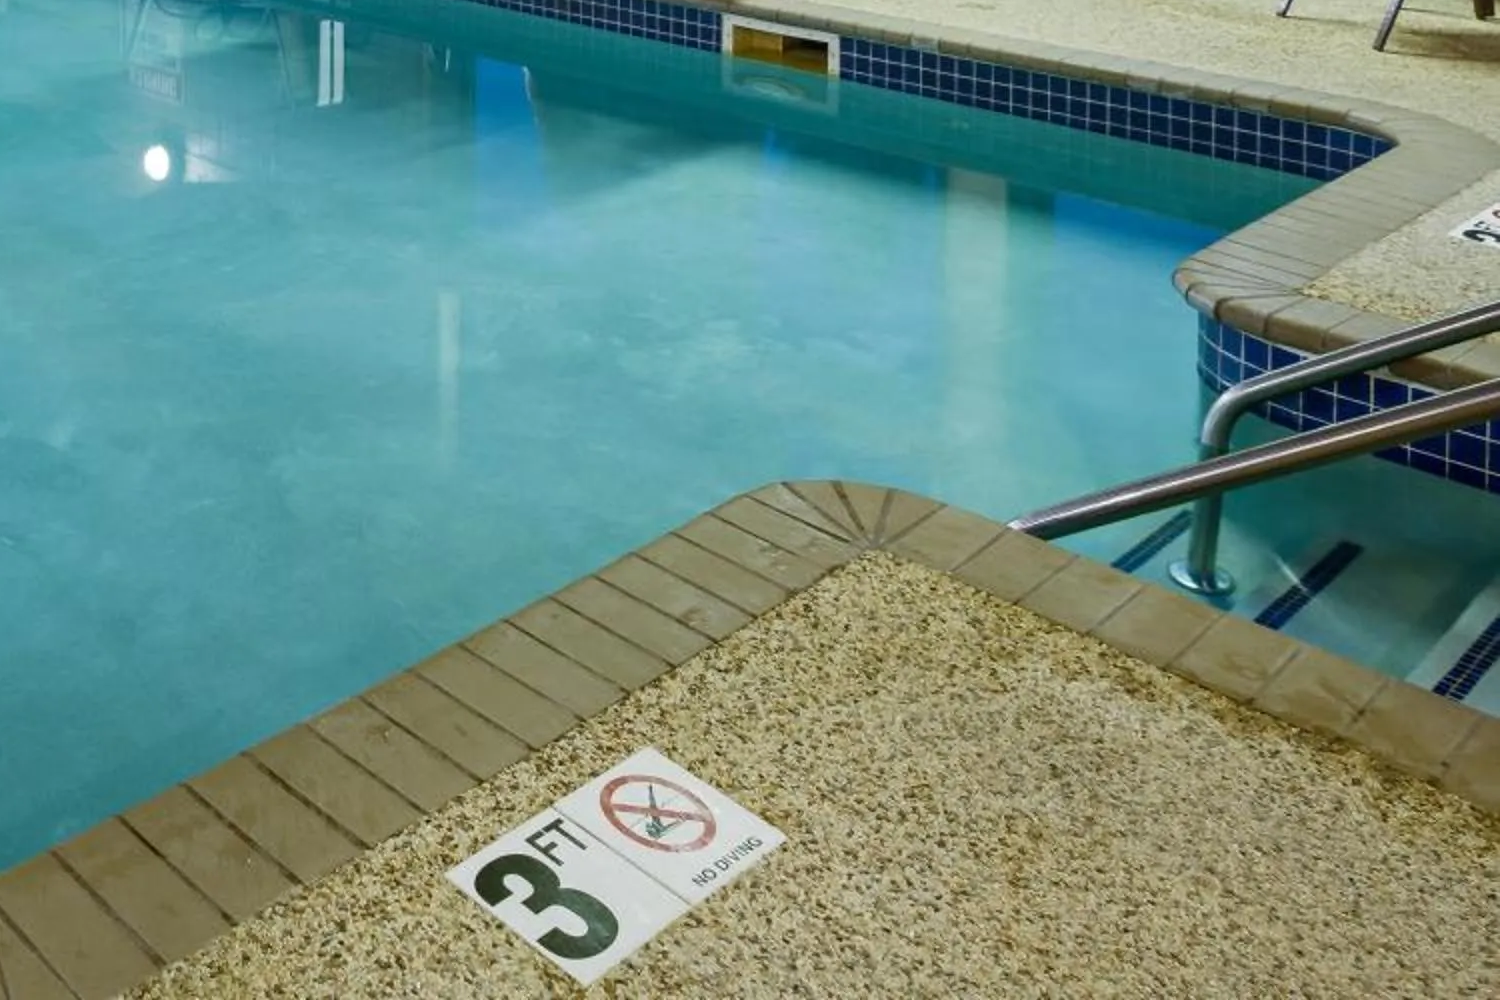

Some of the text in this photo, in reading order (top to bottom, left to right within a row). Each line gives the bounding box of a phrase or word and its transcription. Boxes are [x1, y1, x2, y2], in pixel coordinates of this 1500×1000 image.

[473, 818, 619, 960] 3 FT
[691, 836, 763, 887] NO DIVING
